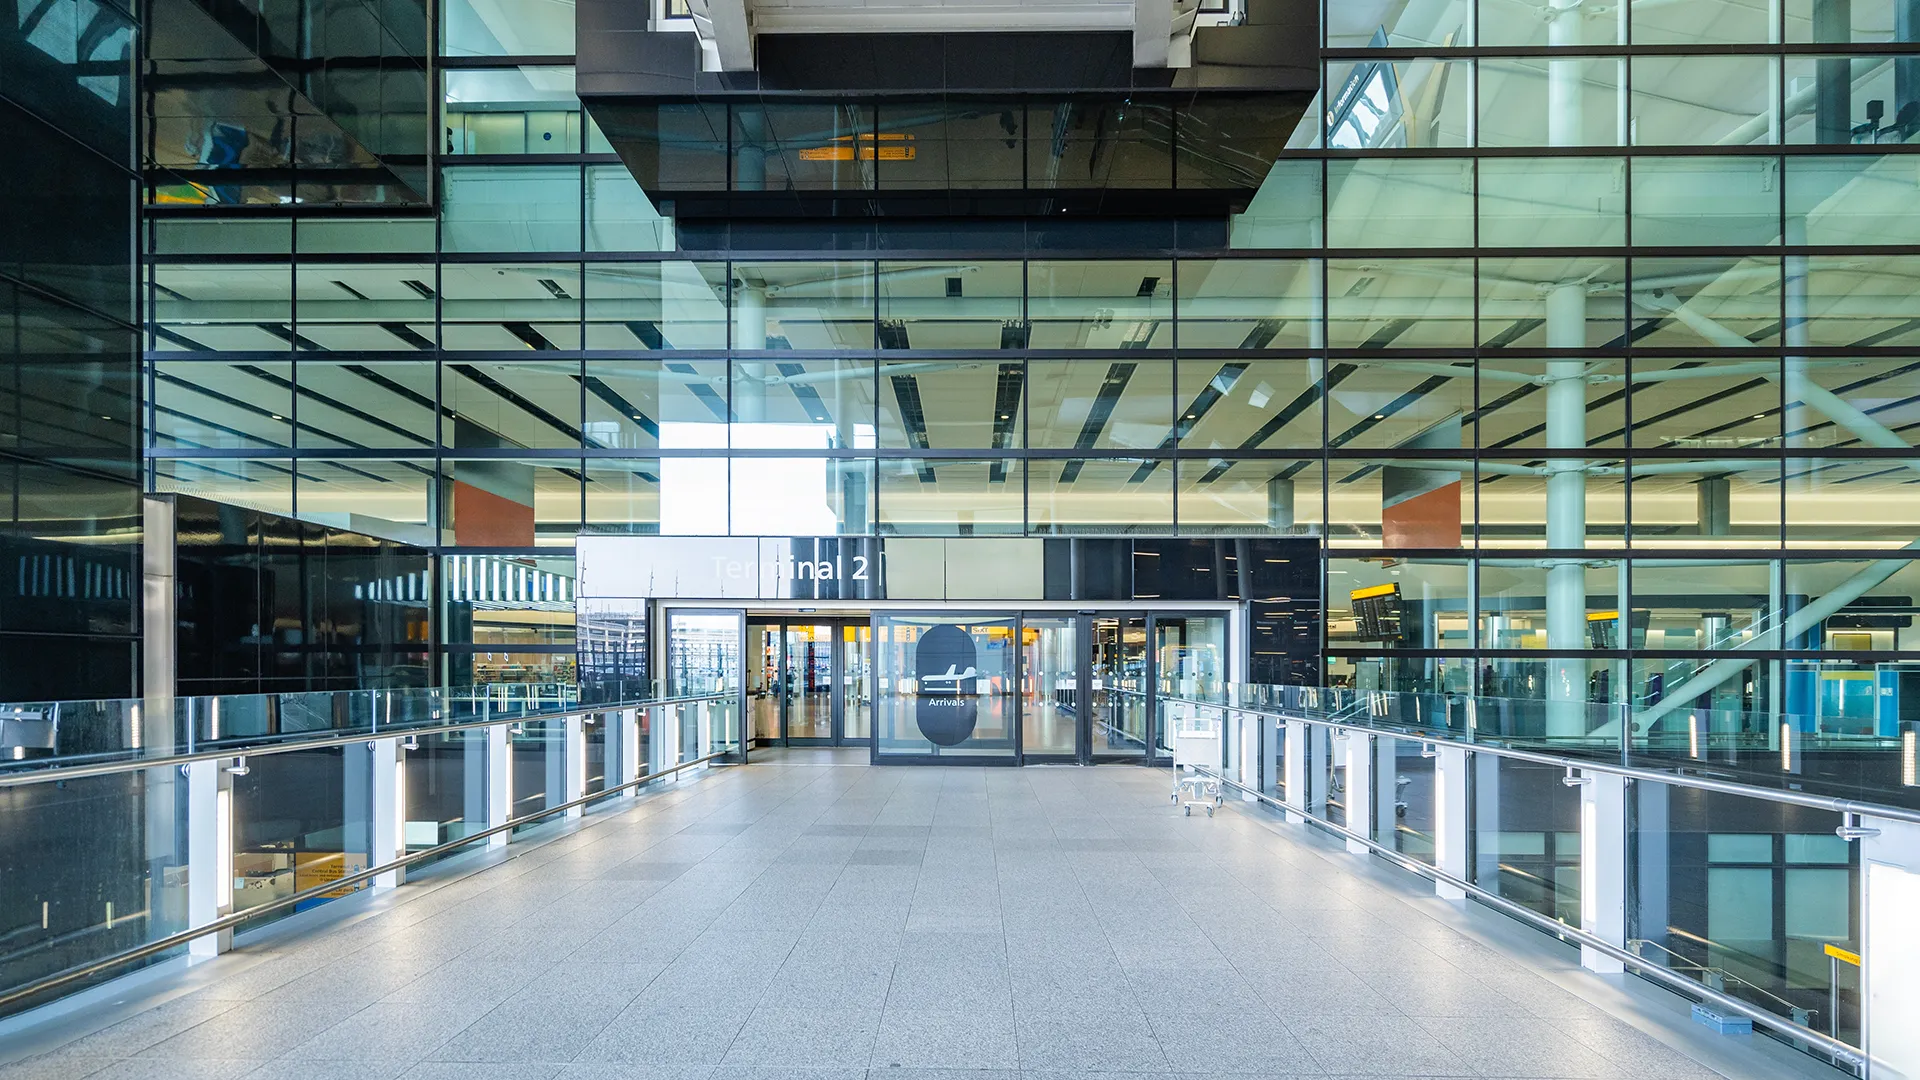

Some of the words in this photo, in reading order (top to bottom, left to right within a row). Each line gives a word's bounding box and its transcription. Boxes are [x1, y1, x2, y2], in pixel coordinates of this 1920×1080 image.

[1334, 74, 1360, 114] Information
[711, 555, 842, 580] Terminal
[852, 556, 869, 580] 2
[928, 698, 965, 707] Arrivals
